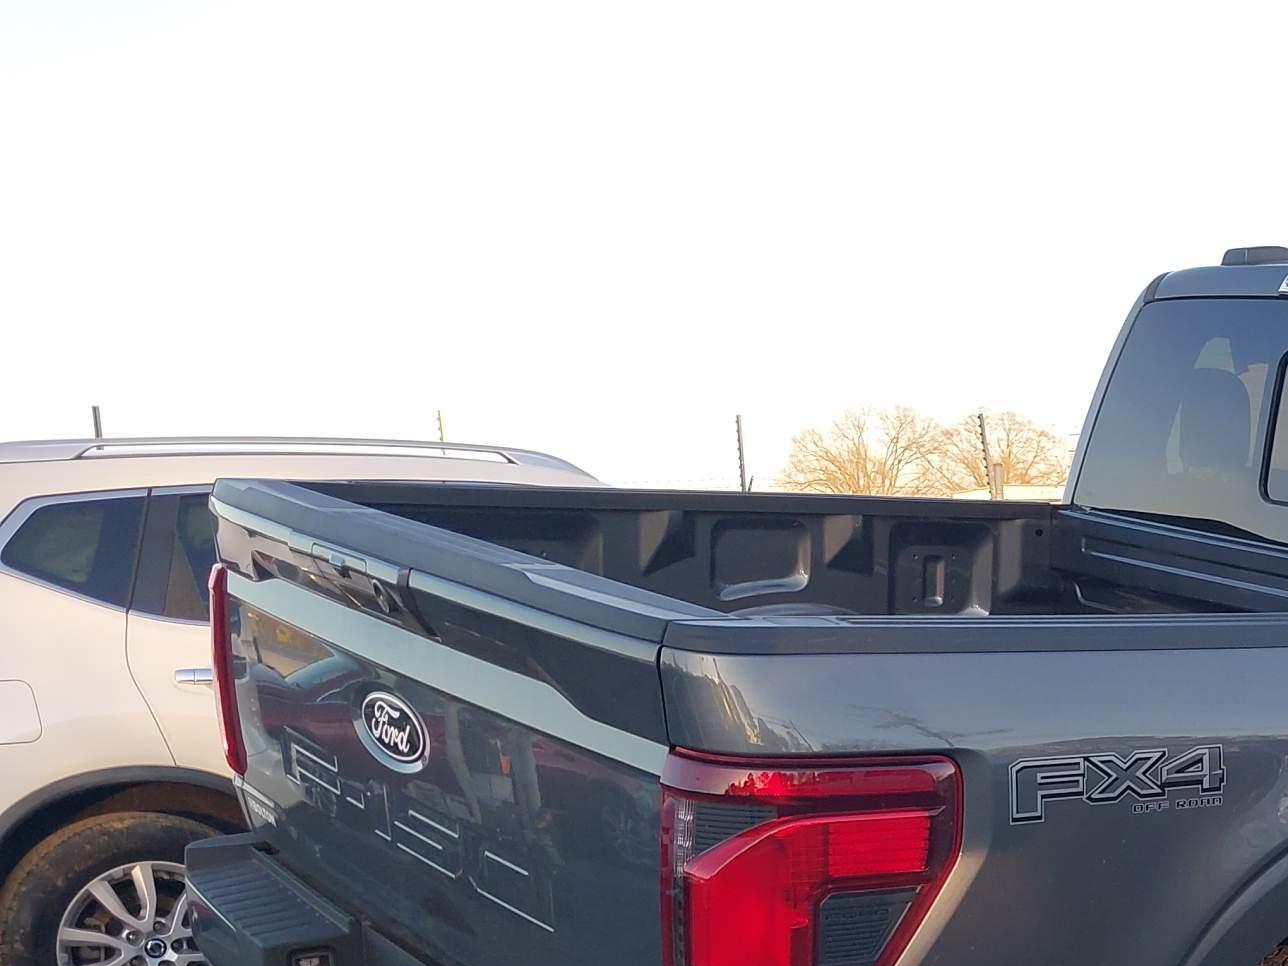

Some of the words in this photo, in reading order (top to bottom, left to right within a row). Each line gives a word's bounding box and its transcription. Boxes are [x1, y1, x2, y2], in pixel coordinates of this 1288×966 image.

[371, 699, 410, 754] Ford
[1008, 743, 1227, 825] FX4
[1132, 800, 1170, 814] OFF
